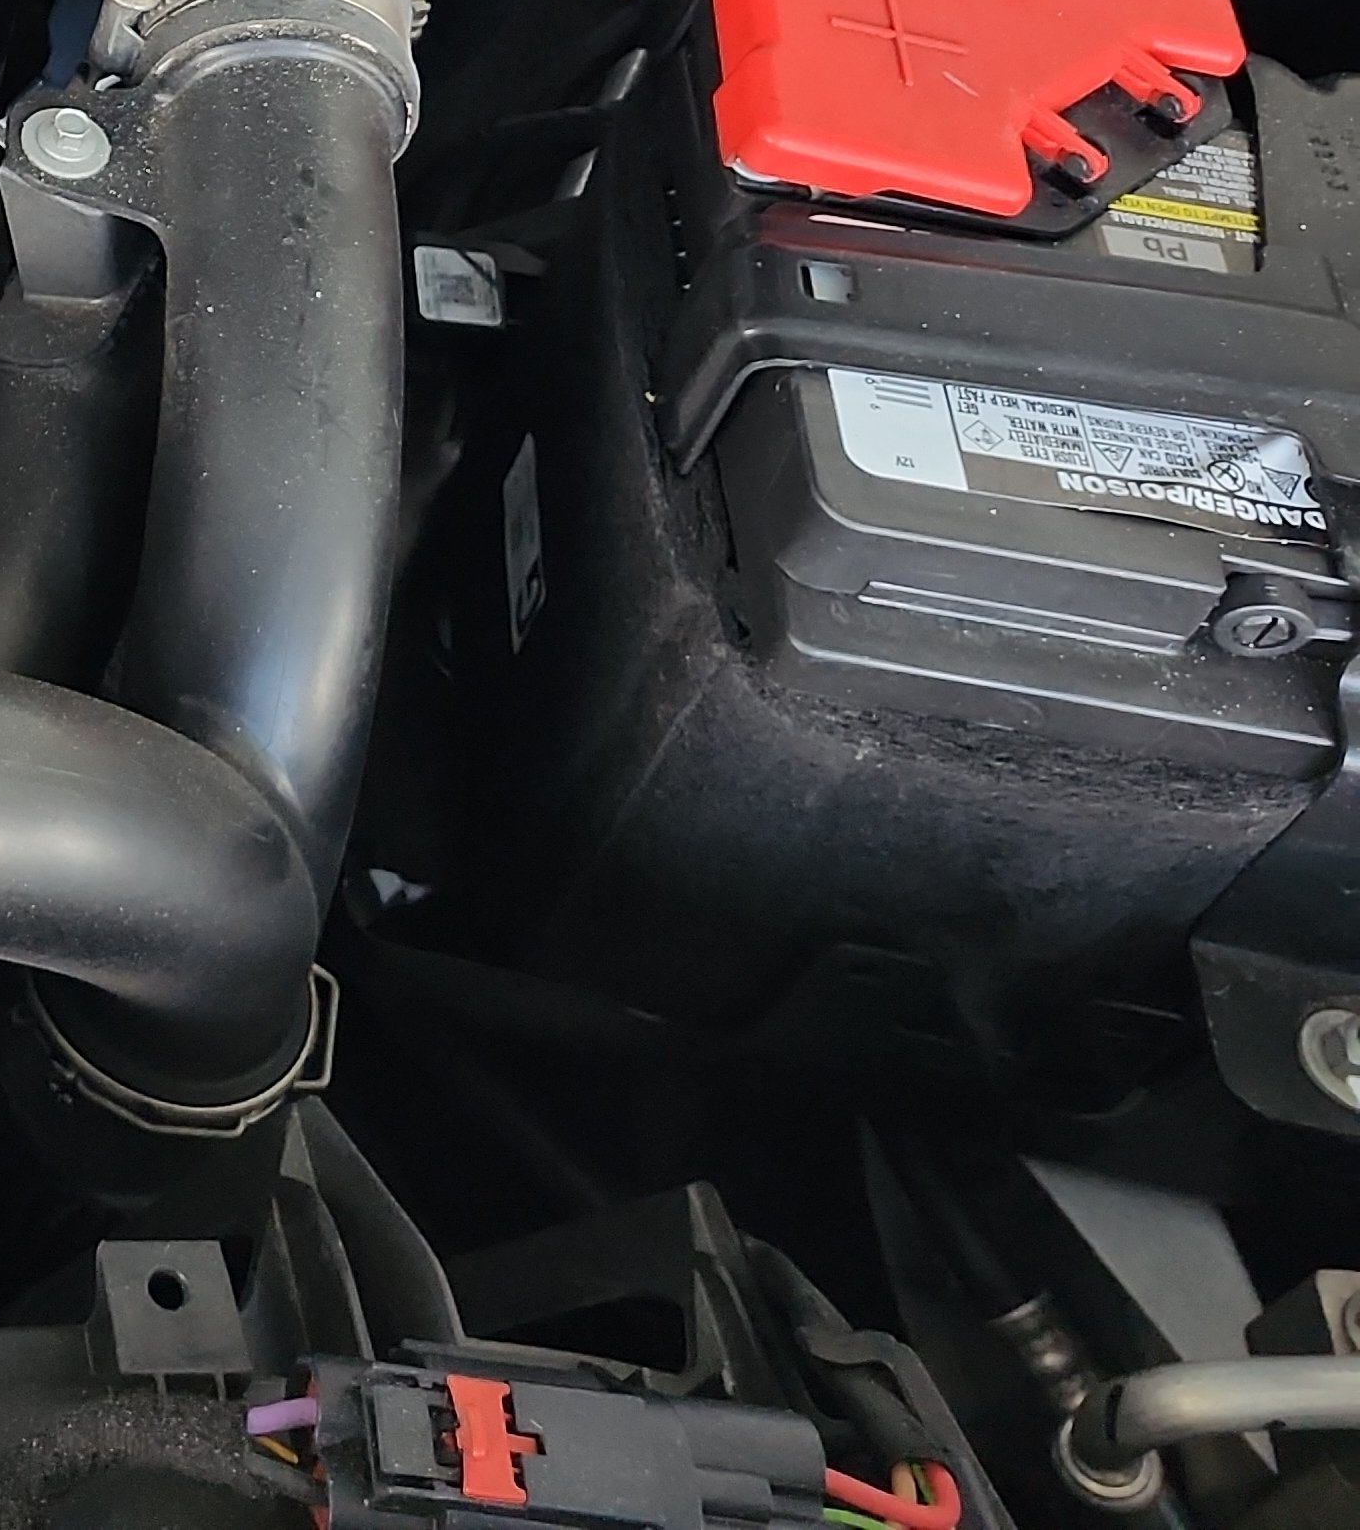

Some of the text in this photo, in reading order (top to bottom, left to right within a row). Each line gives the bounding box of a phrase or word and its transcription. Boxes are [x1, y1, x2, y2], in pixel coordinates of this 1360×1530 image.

[1143, 237, 1189, 262] Pb
[957, 401, 979, 415] GET
[991, 394, 1020, 409] HELP
[1022, 400, 1077, 418] MEDICAL
[896, 455, 915, 468] 12V
[1051, 450, 1089, 467] FLUSH
[1056, 471, 1328, 531] DANGER/POISON
